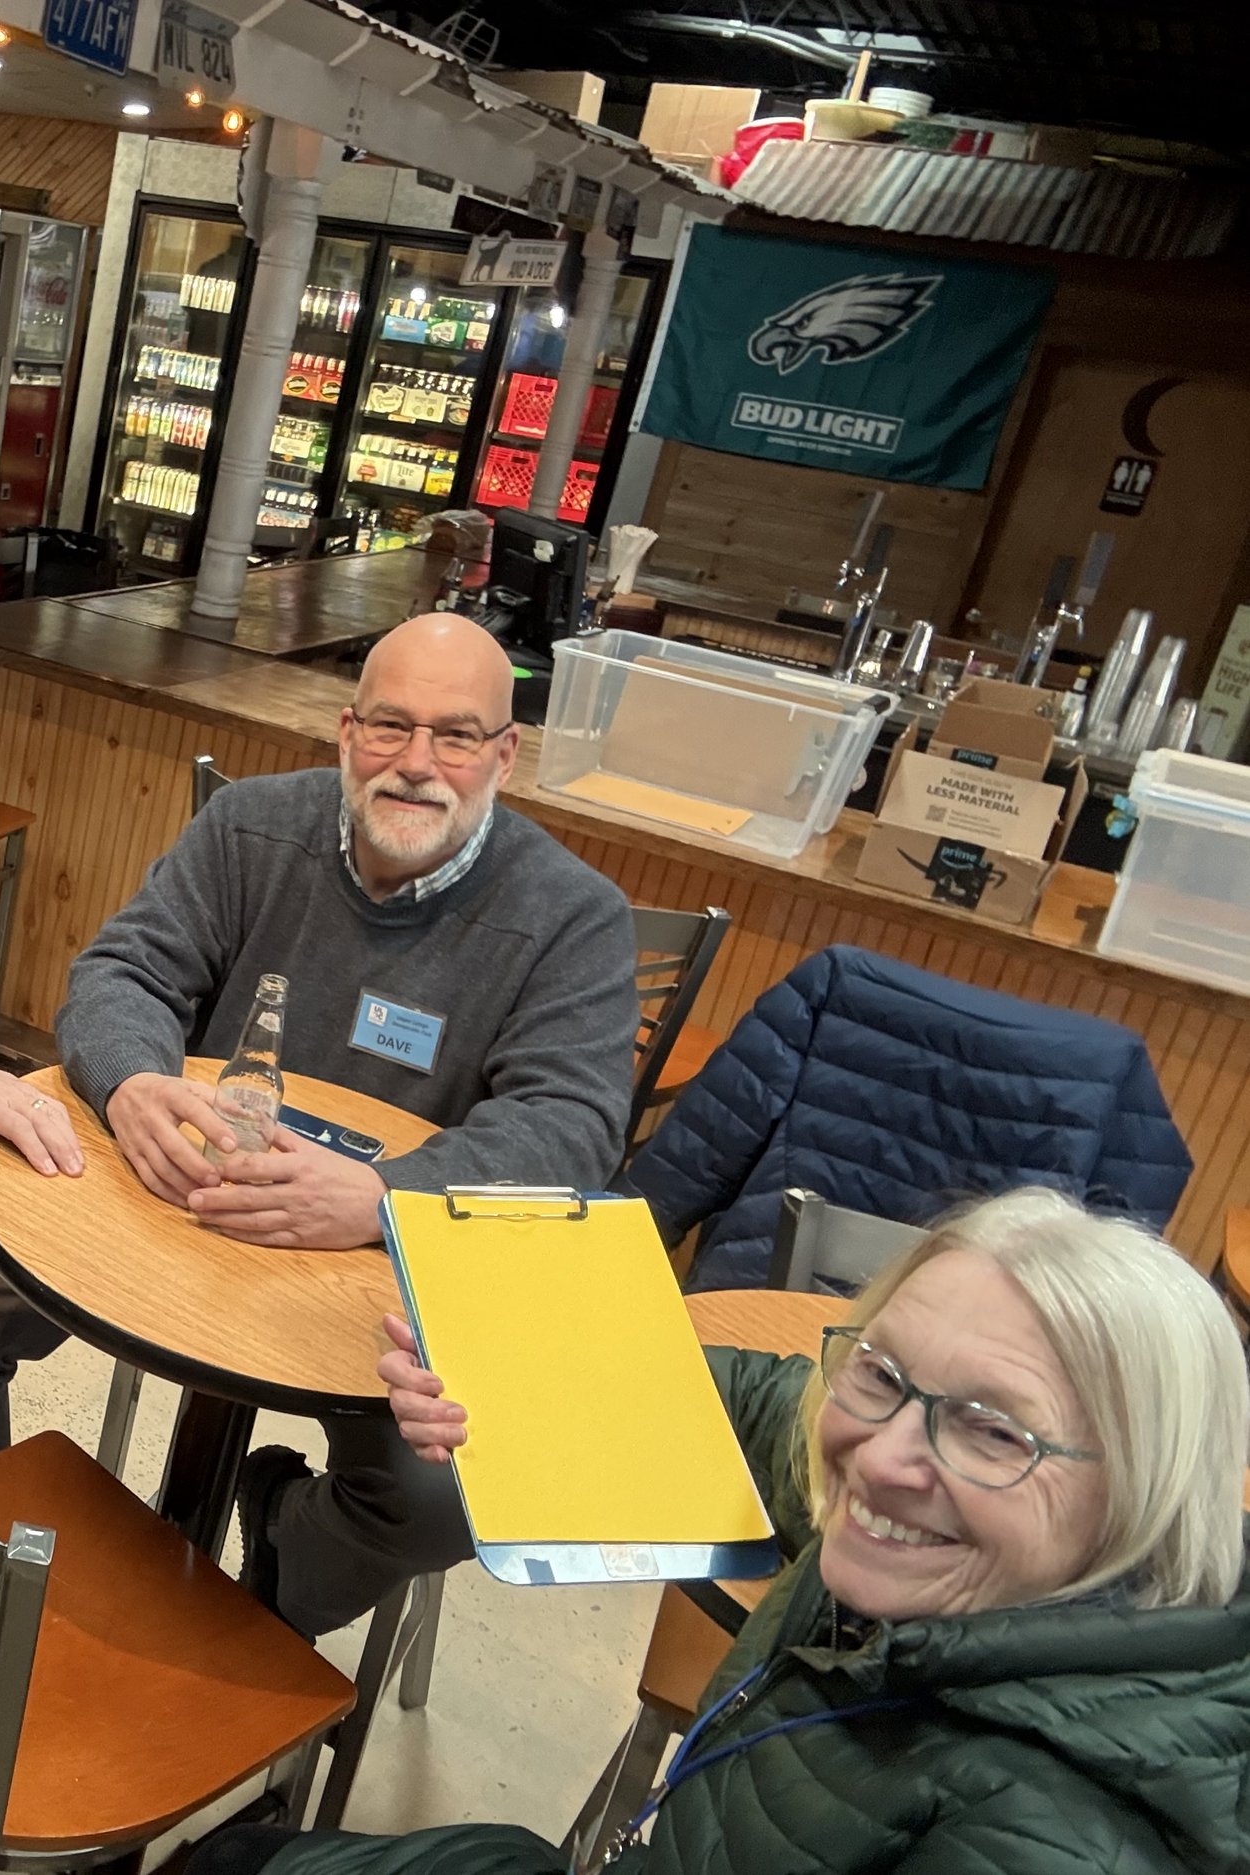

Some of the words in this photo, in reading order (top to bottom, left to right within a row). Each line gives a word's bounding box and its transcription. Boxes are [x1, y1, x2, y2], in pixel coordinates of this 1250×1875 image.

[507, 260, 527, 279] AND
[532, 261, 553, 280] DOG
[738, 400, 803, 429] BUD
[804, 409, 897, 446] LIGHT
[396, 464, 415, 477] Lite
[1218, 663, 1250, 687] HIGH
[1214, 678, 1243, 700] LIFE
[956, 748, 994, 766] prime
[926, 784, 956, 800] LESS
[957, 792, 1021, 816] MATERIAL
[940, 776, 978, 794] MADE
[980, 786, 1015, 803] WITH
[940, 845, 978, 861] prime
[376, 1033, 413, 1054] DAVE
